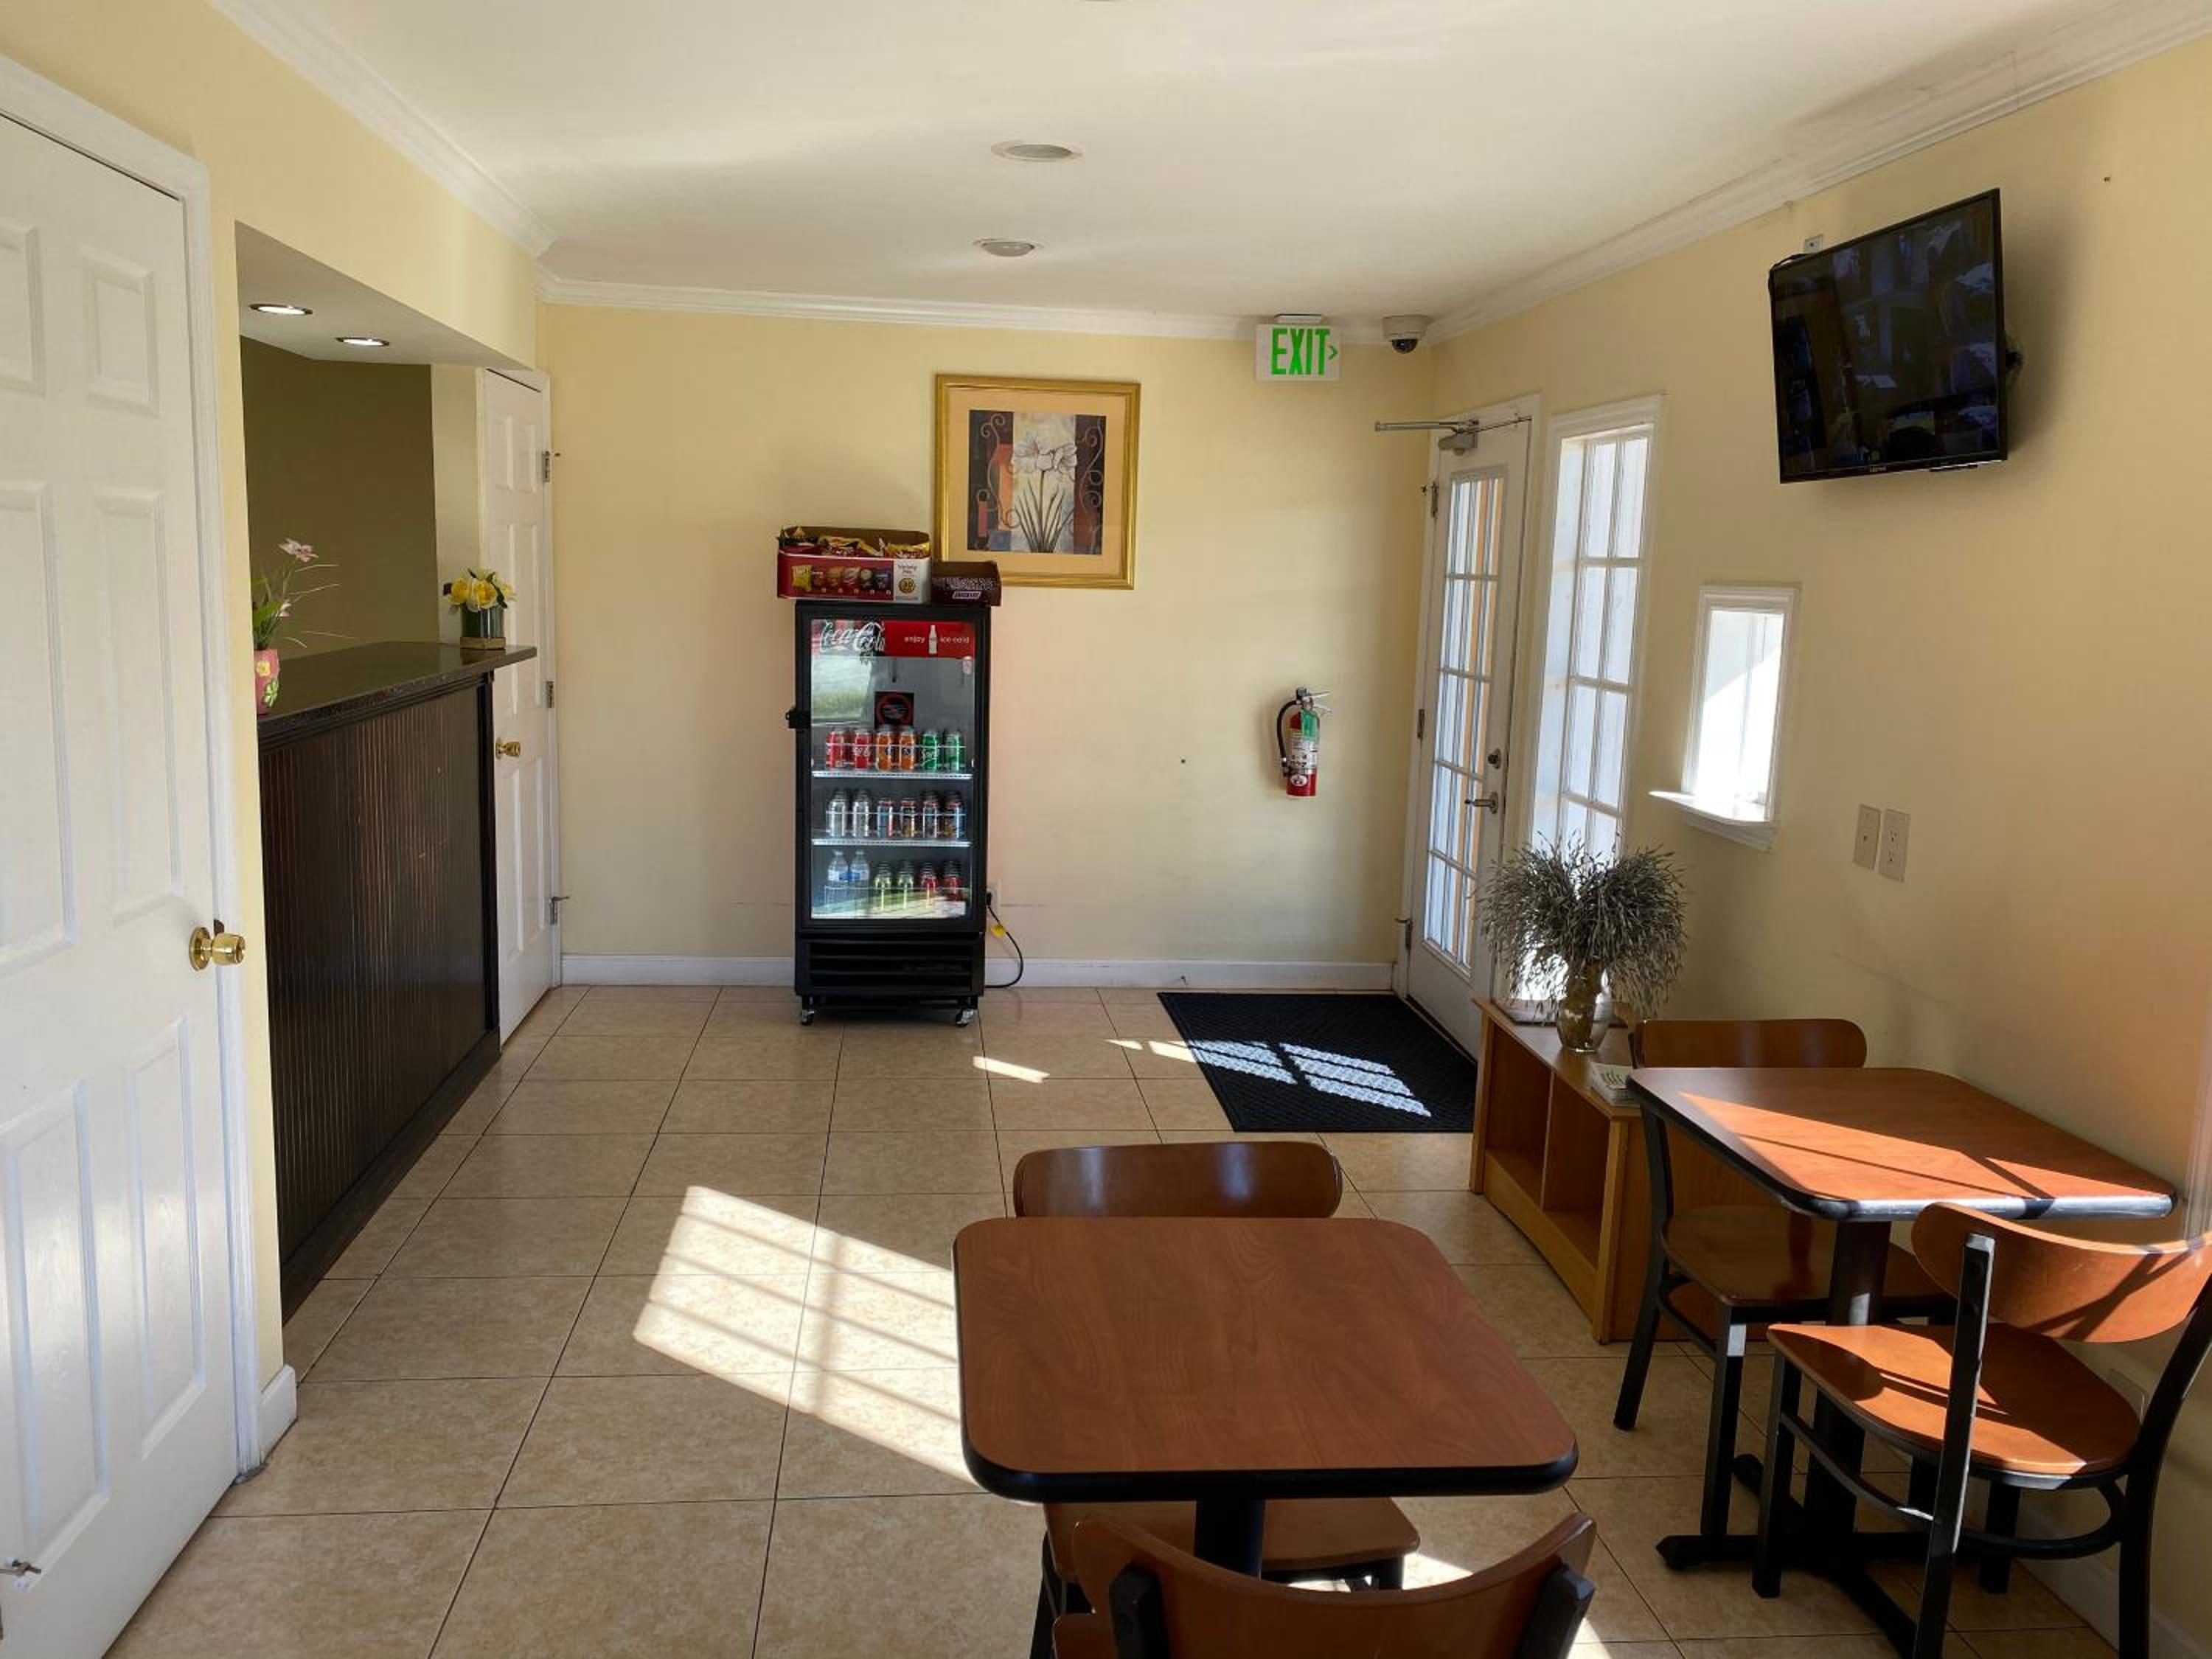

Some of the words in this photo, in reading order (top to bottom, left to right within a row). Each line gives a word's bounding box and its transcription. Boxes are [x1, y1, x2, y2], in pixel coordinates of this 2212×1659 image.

[1272, 328, 1330, 375] EXIT
[904, 635, 925, 644] enjoy
[940, 634, 951, 643] ice
[952, 636, 970, 644] cold
